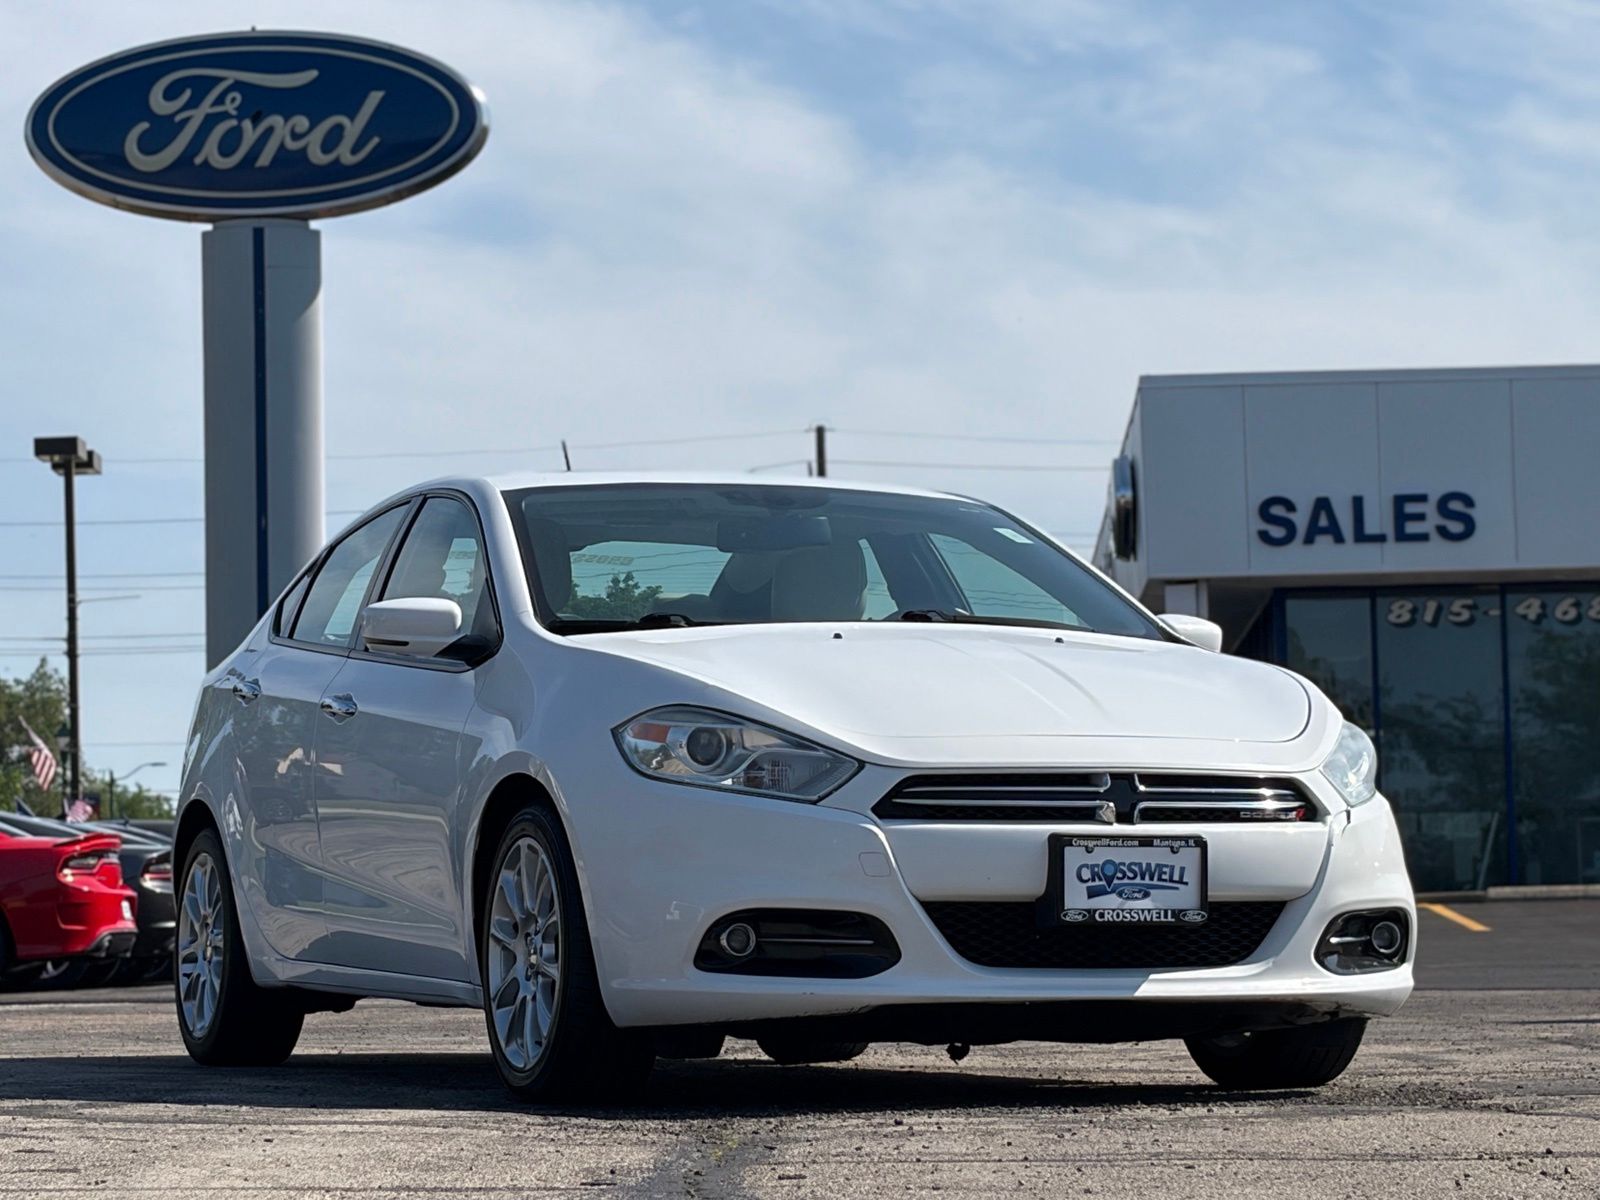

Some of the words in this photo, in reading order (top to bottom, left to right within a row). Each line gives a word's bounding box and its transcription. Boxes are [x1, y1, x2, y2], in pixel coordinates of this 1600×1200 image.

[124, 68, 386, 172] Ford
[1257, 491, 1477, 546] SALES
[1076, 860, 1188, 886] CROSSWELL
[1121, 887, 1145, 899] Ford
[1094, 909, 1175, 922] CROSSWELL
